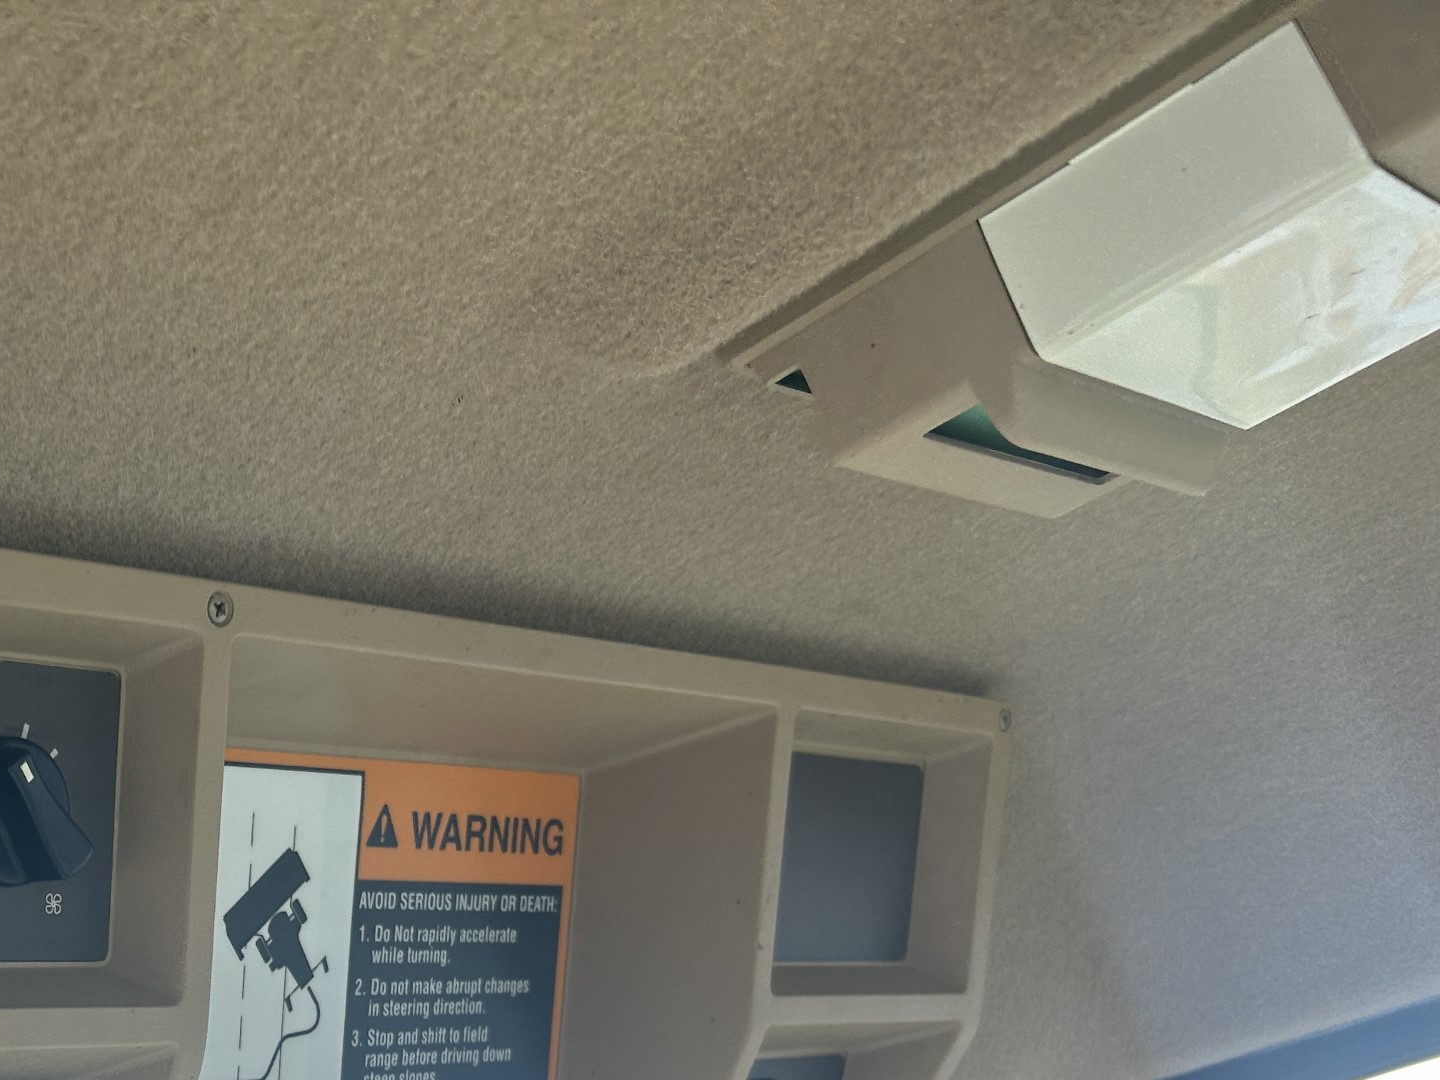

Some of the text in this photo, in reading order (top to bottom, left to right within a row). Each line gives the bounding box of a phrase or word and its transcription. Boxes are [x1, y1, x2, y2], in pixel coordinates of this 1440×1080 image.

[412, 811, 564, 856] WARNING
[359, 892, 558, 912] AVOID SERIOUS INJURY OR DEATH:
[359, 925, 517, 946] 1. Do Not rapidly accelerate
[372, 947, 450, 966] while turning.
[355, 977, 529, 997] 2. Do not make abrupt changes
[368, 998, 485, 1019] in steering direction.
[352, 1026, 488, 1048] 3. Stop and shift to field
[365, 1047, 511, 1070] range before driving down
